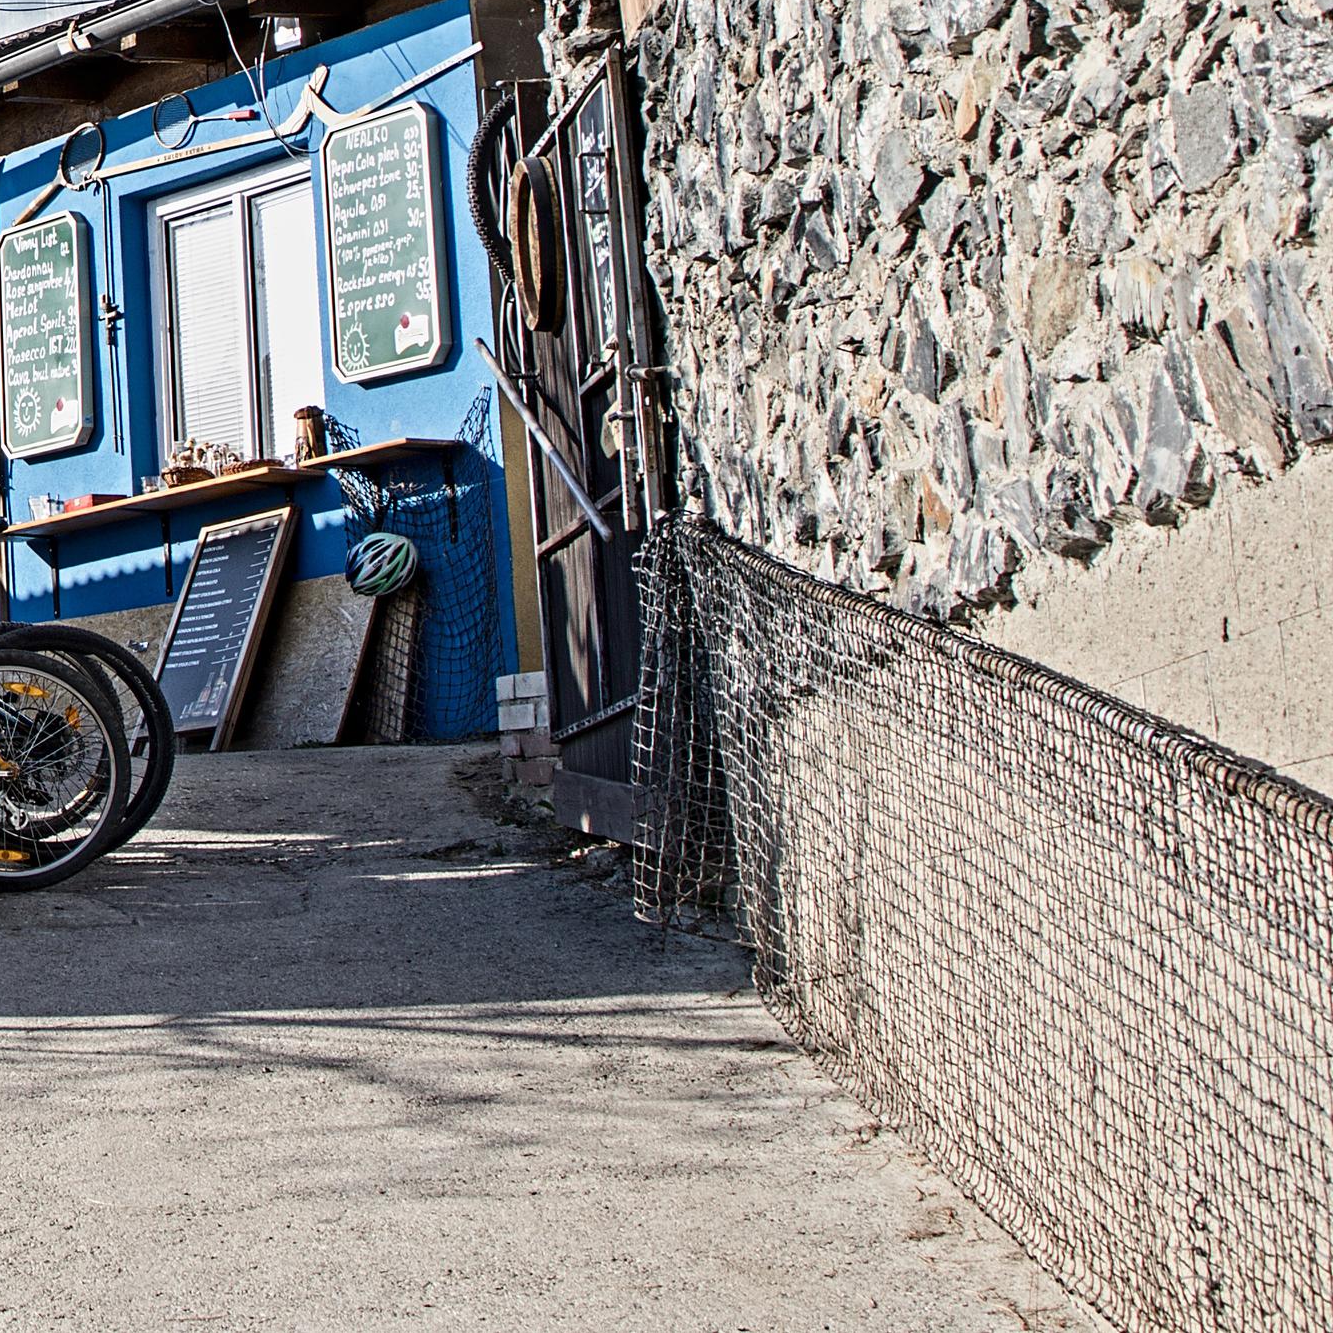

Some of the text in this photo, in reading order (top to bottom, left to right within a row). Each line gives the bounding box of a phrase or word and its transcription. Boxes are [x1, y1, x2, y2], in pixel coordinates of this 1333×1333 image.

[346, 126, 388, 150] NEALKO
[331, 160, 354, 183] Pepsi
[356, 153, 375, 171] Cola
[336, 221, 370, 245] Granini
[4, 261, 53, 281] Chardonnay
[379, 269, 405, 286] energy
[6, 296, 38, 320] Merlot
[339, 292, 395, 321] Espresso
[6, 317, 38, 350] Aperol
[7, 346, 45, 366] Prosecco
